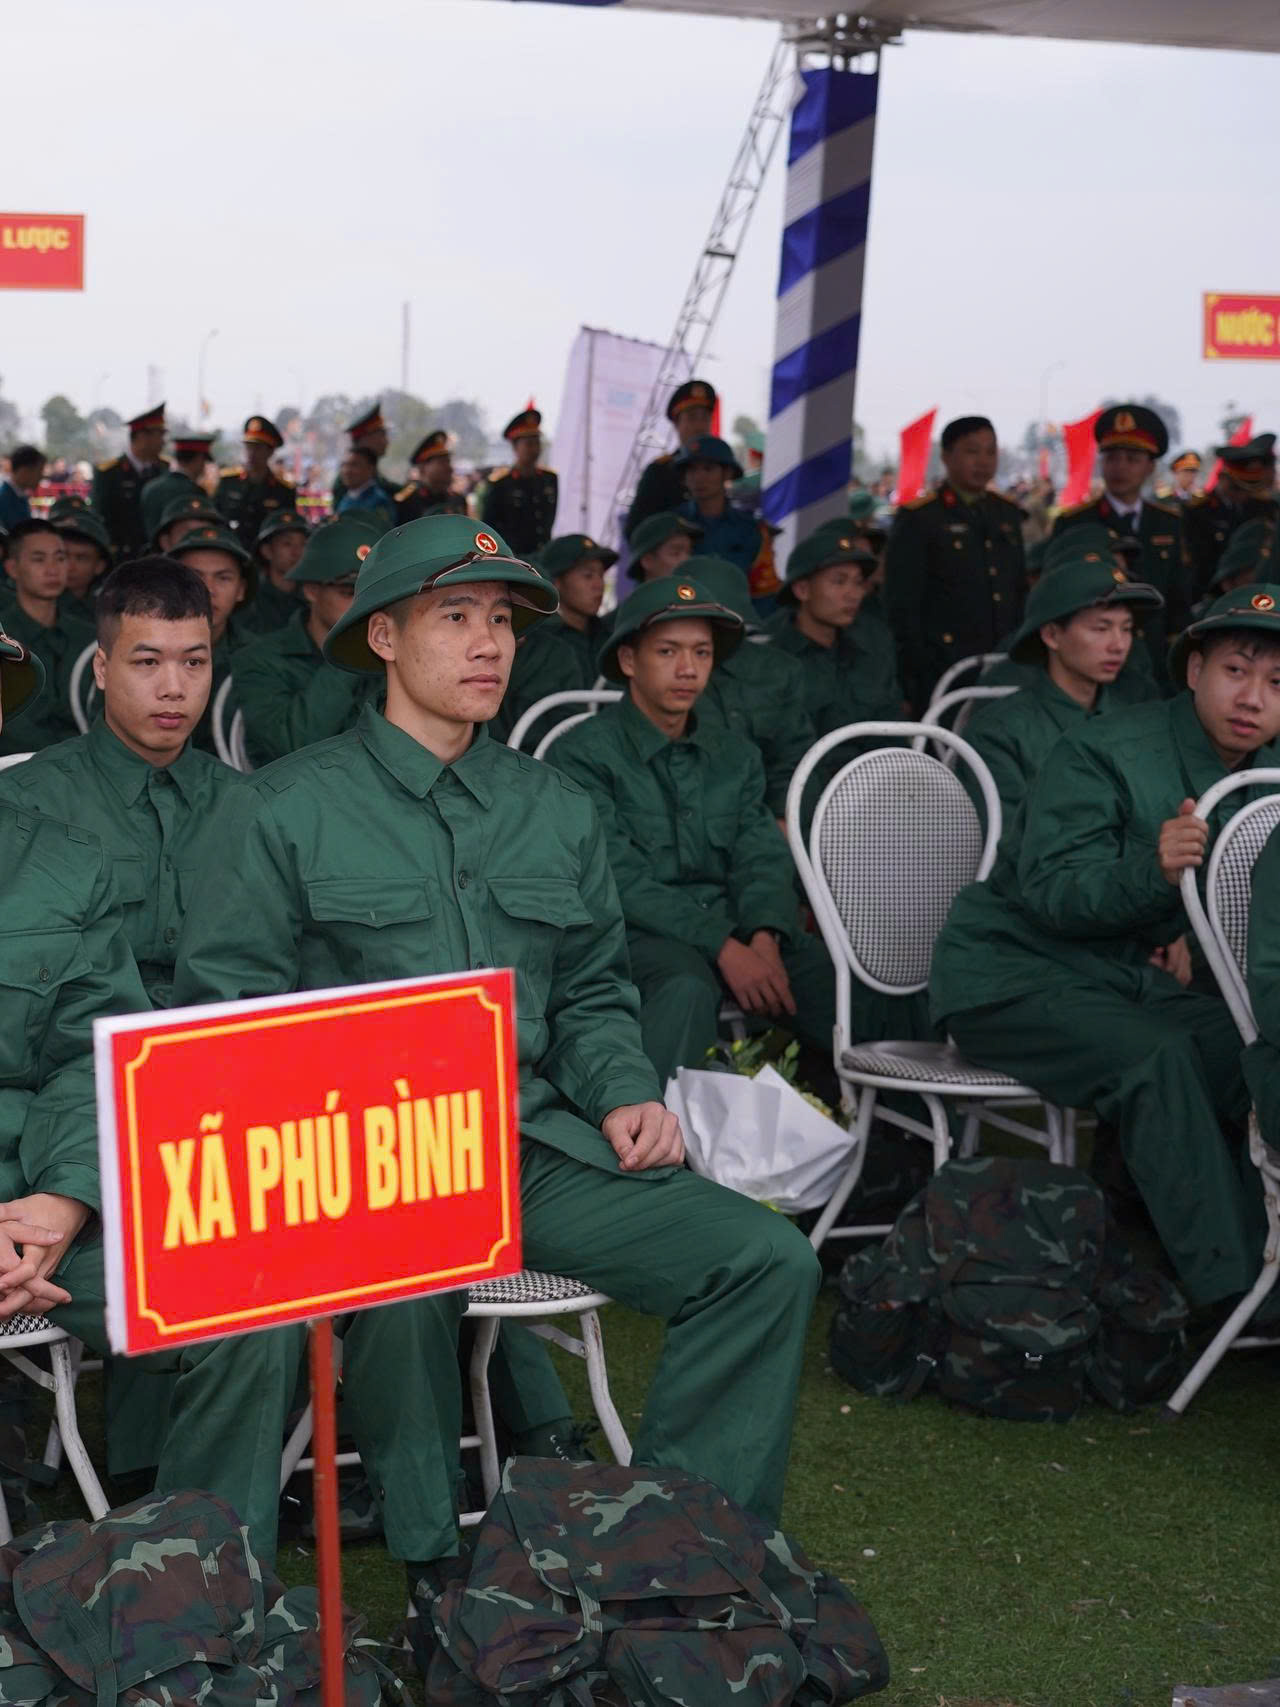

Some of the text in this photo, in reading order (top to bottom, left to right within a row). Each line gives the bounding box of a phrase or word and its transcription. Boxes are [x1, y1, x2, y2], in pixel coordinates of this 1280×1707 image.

[3, 226, 70, 254] LƯỢC
[158, 1078, 484, 1250] XÃ PHÚ BÌNH
